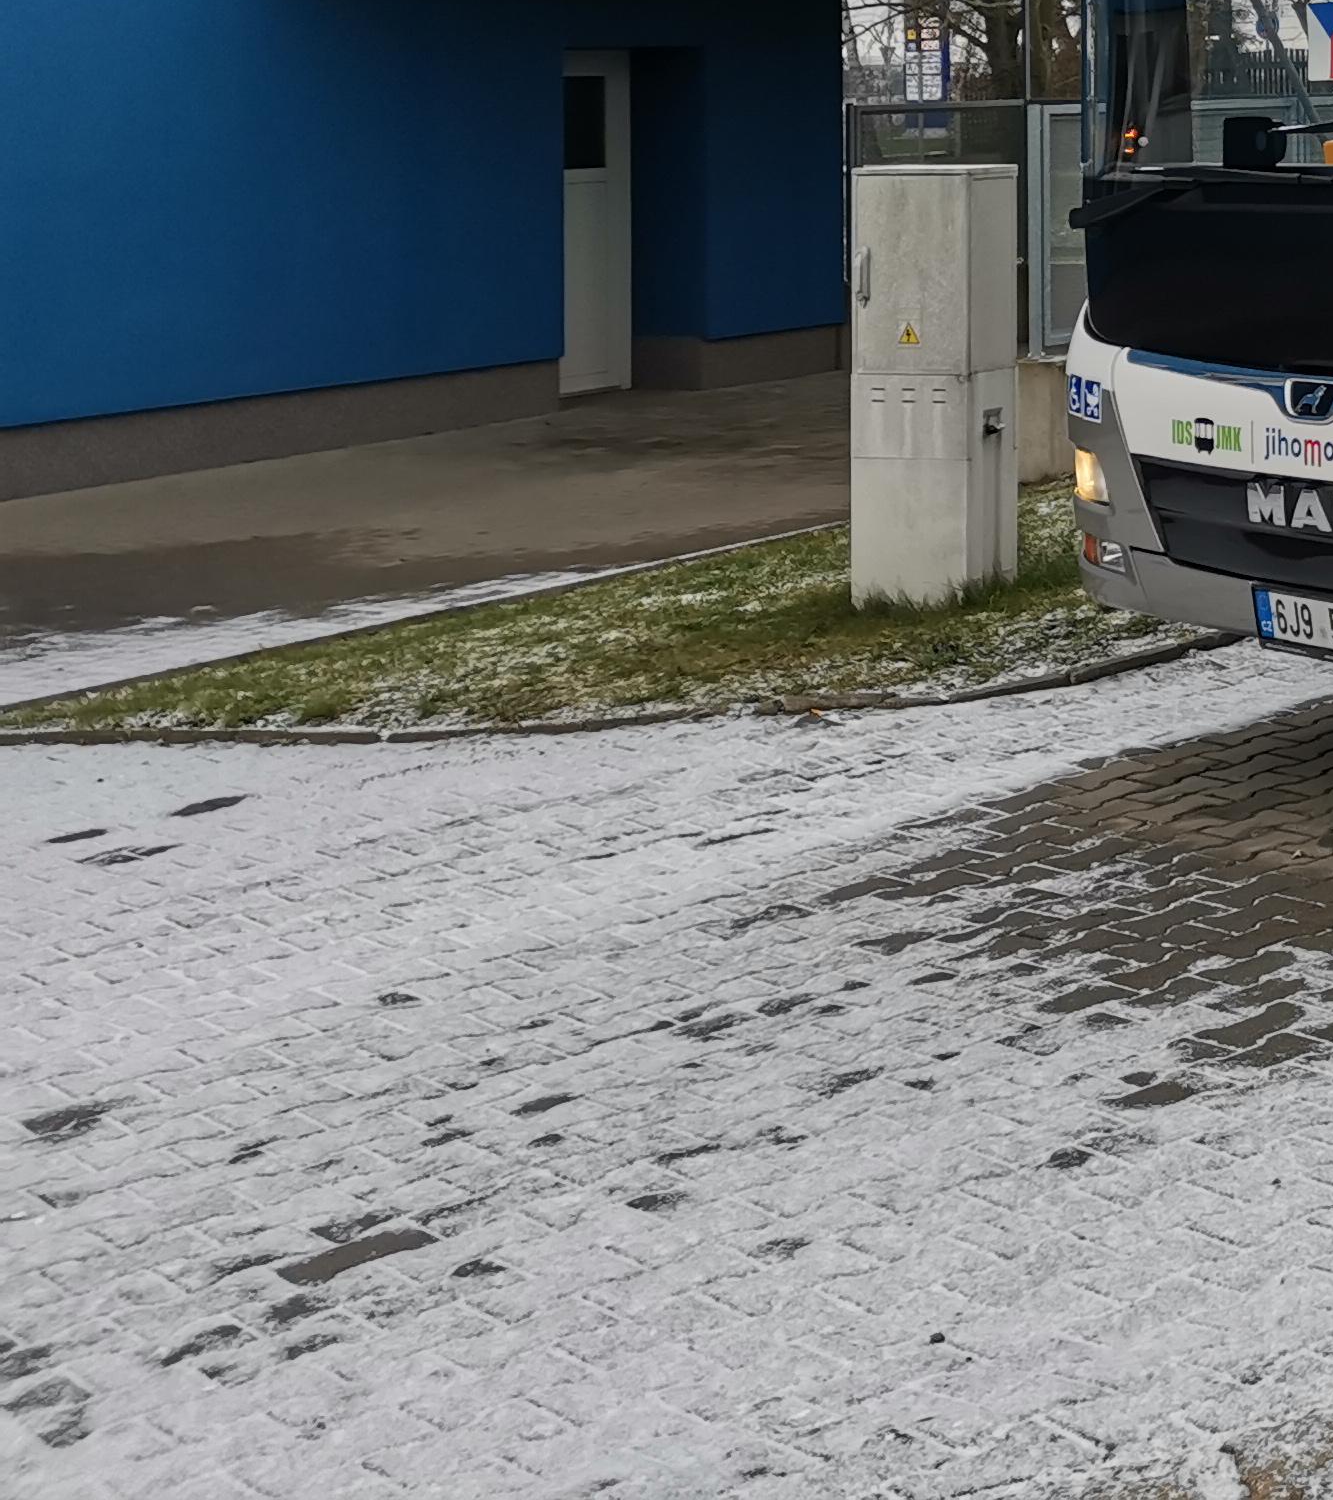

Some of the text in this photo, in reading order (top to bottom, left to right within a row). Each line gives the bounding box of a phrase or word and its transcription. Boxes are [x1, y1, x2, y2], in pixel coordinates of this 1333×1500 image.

[1172, 419, 1192, 445] IDS
[1215, 425, 1242, 452] JMK
[1275, 599, 1314, 640] 6J9
